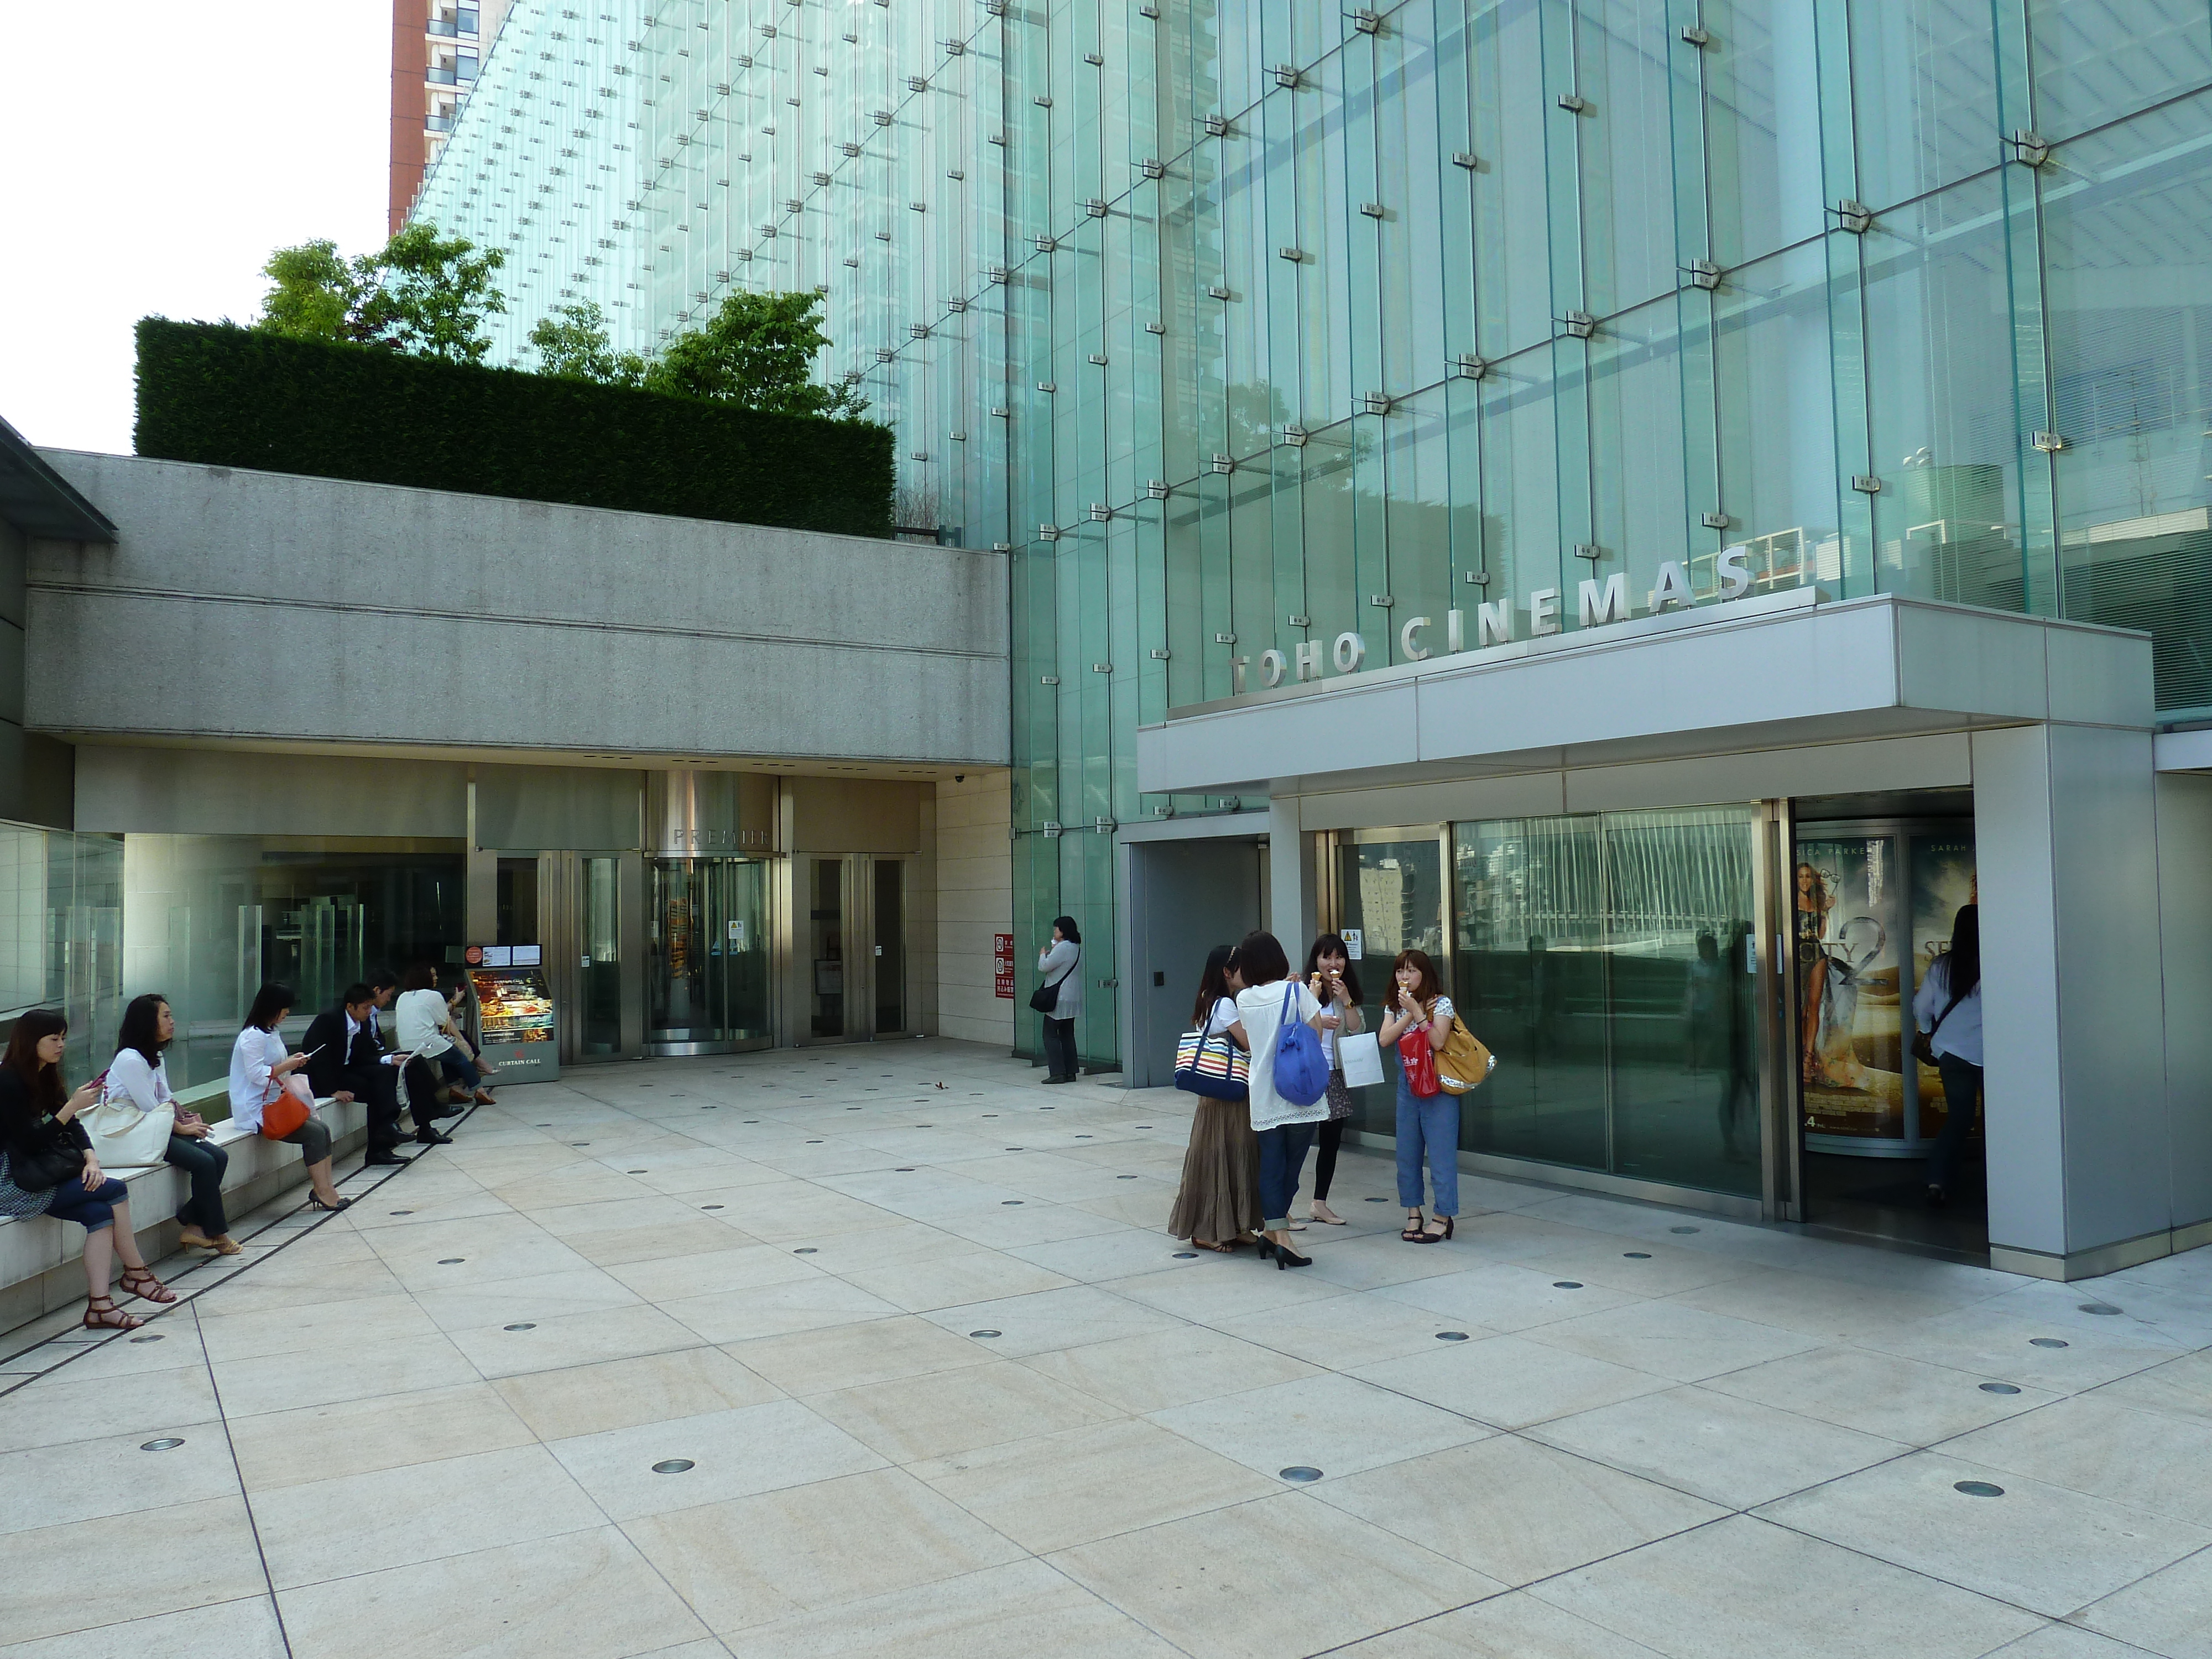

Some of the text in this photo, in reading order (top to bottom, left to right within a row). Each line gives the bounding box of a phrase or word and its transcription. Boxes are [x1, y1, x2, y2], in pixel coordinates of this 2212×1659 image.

[1229, 546, 1755, 694] TOHO CINEMAS
[674, 829, 768, 844] PREMIER
[1828, 847, 1872, 855] PARKER
[1839, 916, 1888, 985] 2
